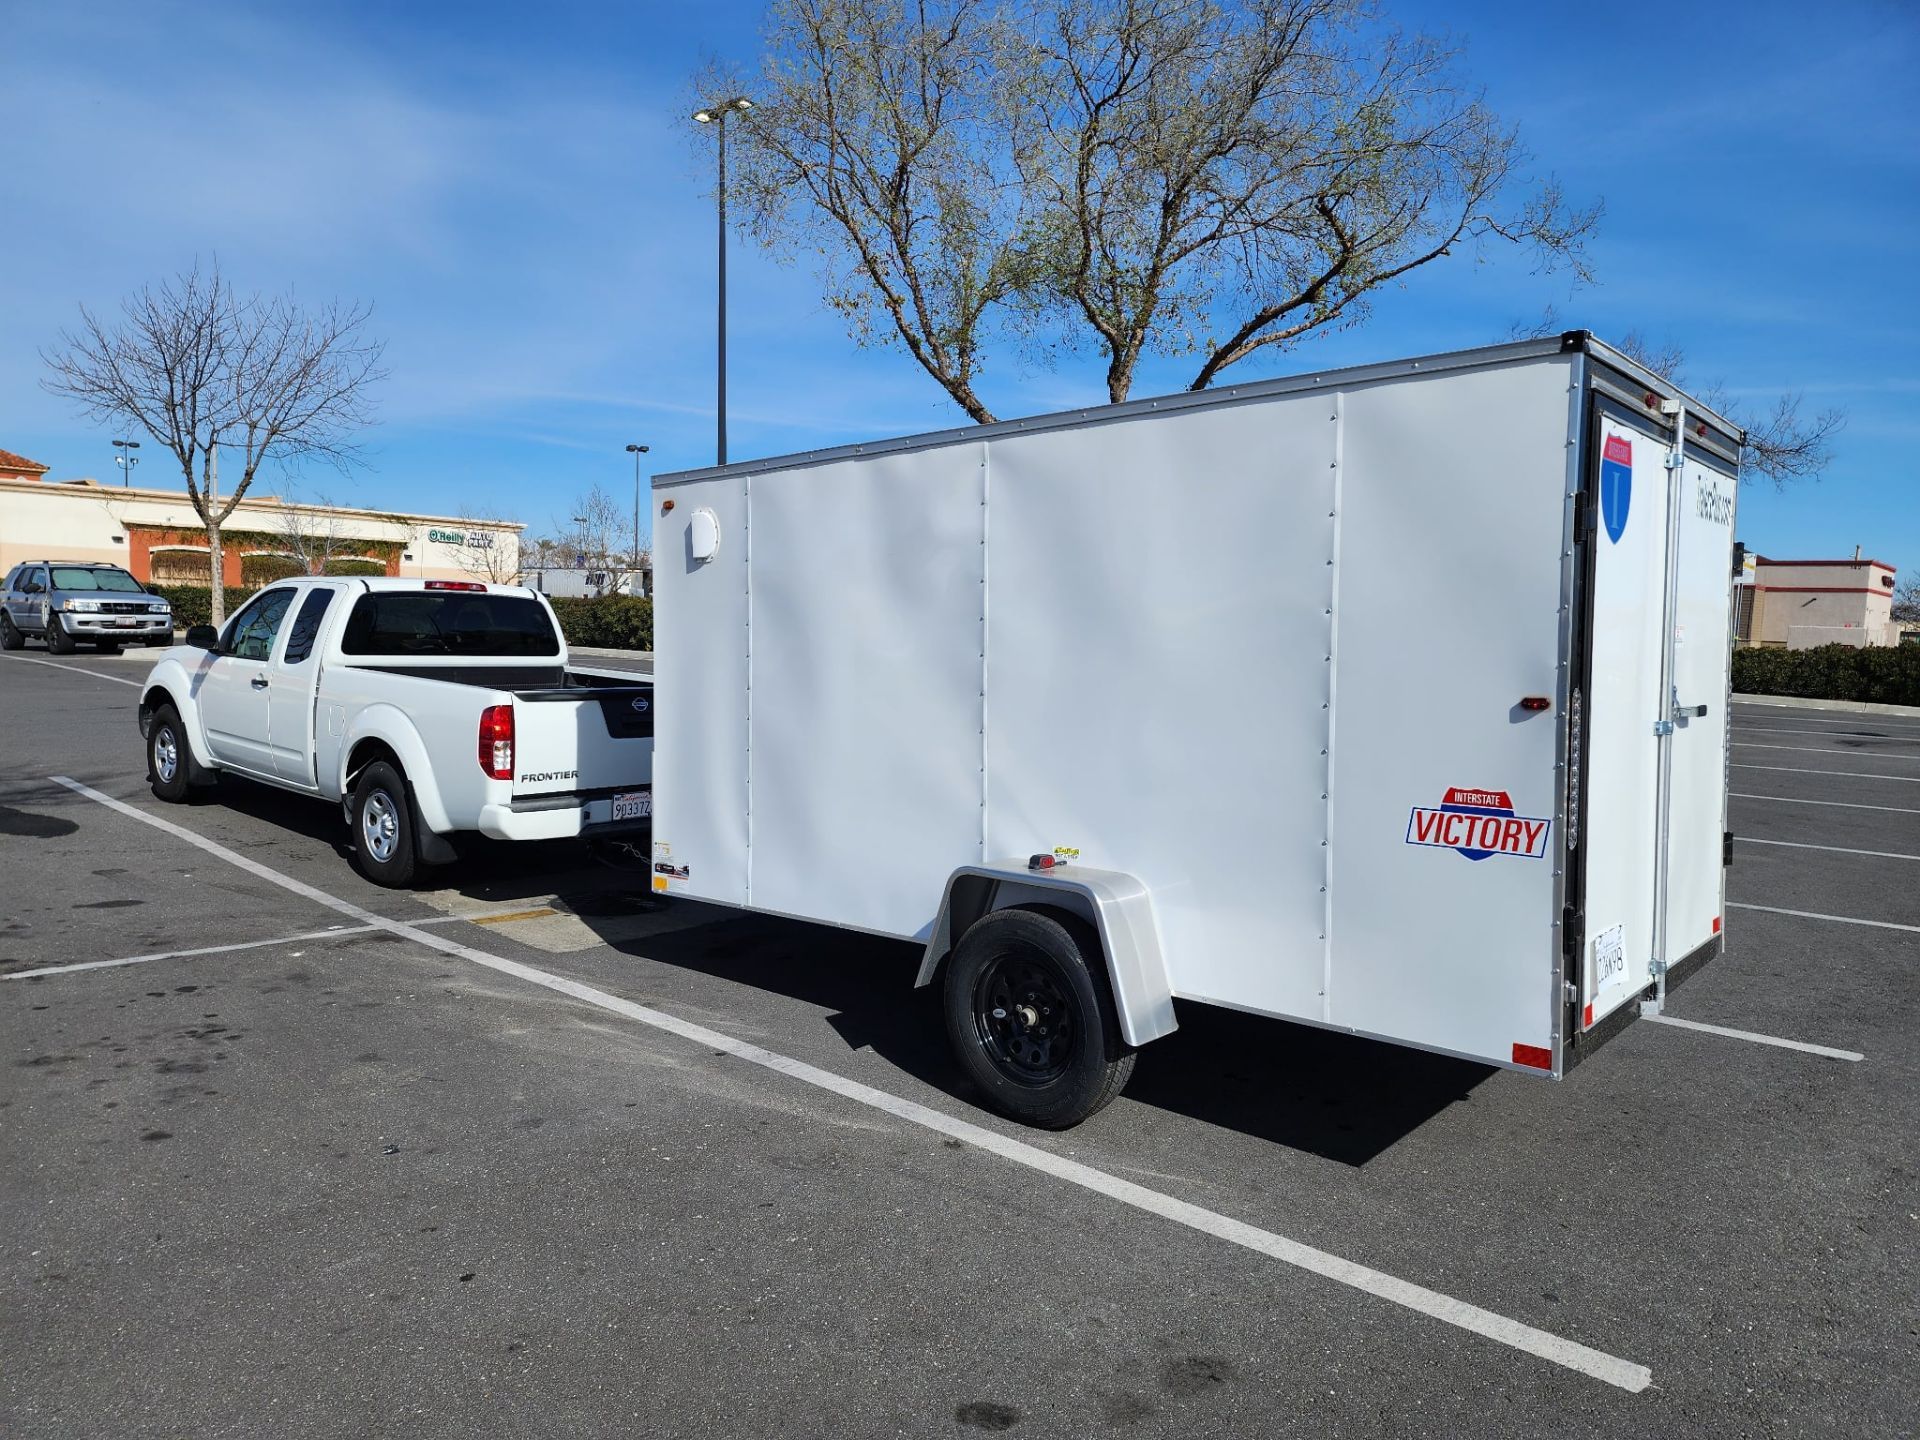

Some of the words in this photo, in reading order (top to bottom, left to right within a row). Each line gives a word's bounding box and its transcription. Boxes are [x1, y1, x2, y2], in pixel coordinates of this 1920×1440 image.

[429, 529, 465, 545] O'Reilly
[521, 770, 580, 783] FRONTIER
[1454, 791, 1501, 806] INTERSTATE
[615, 800, 653, 818] 90337Z
[1416, 810, 1545, 854] VICTORY
